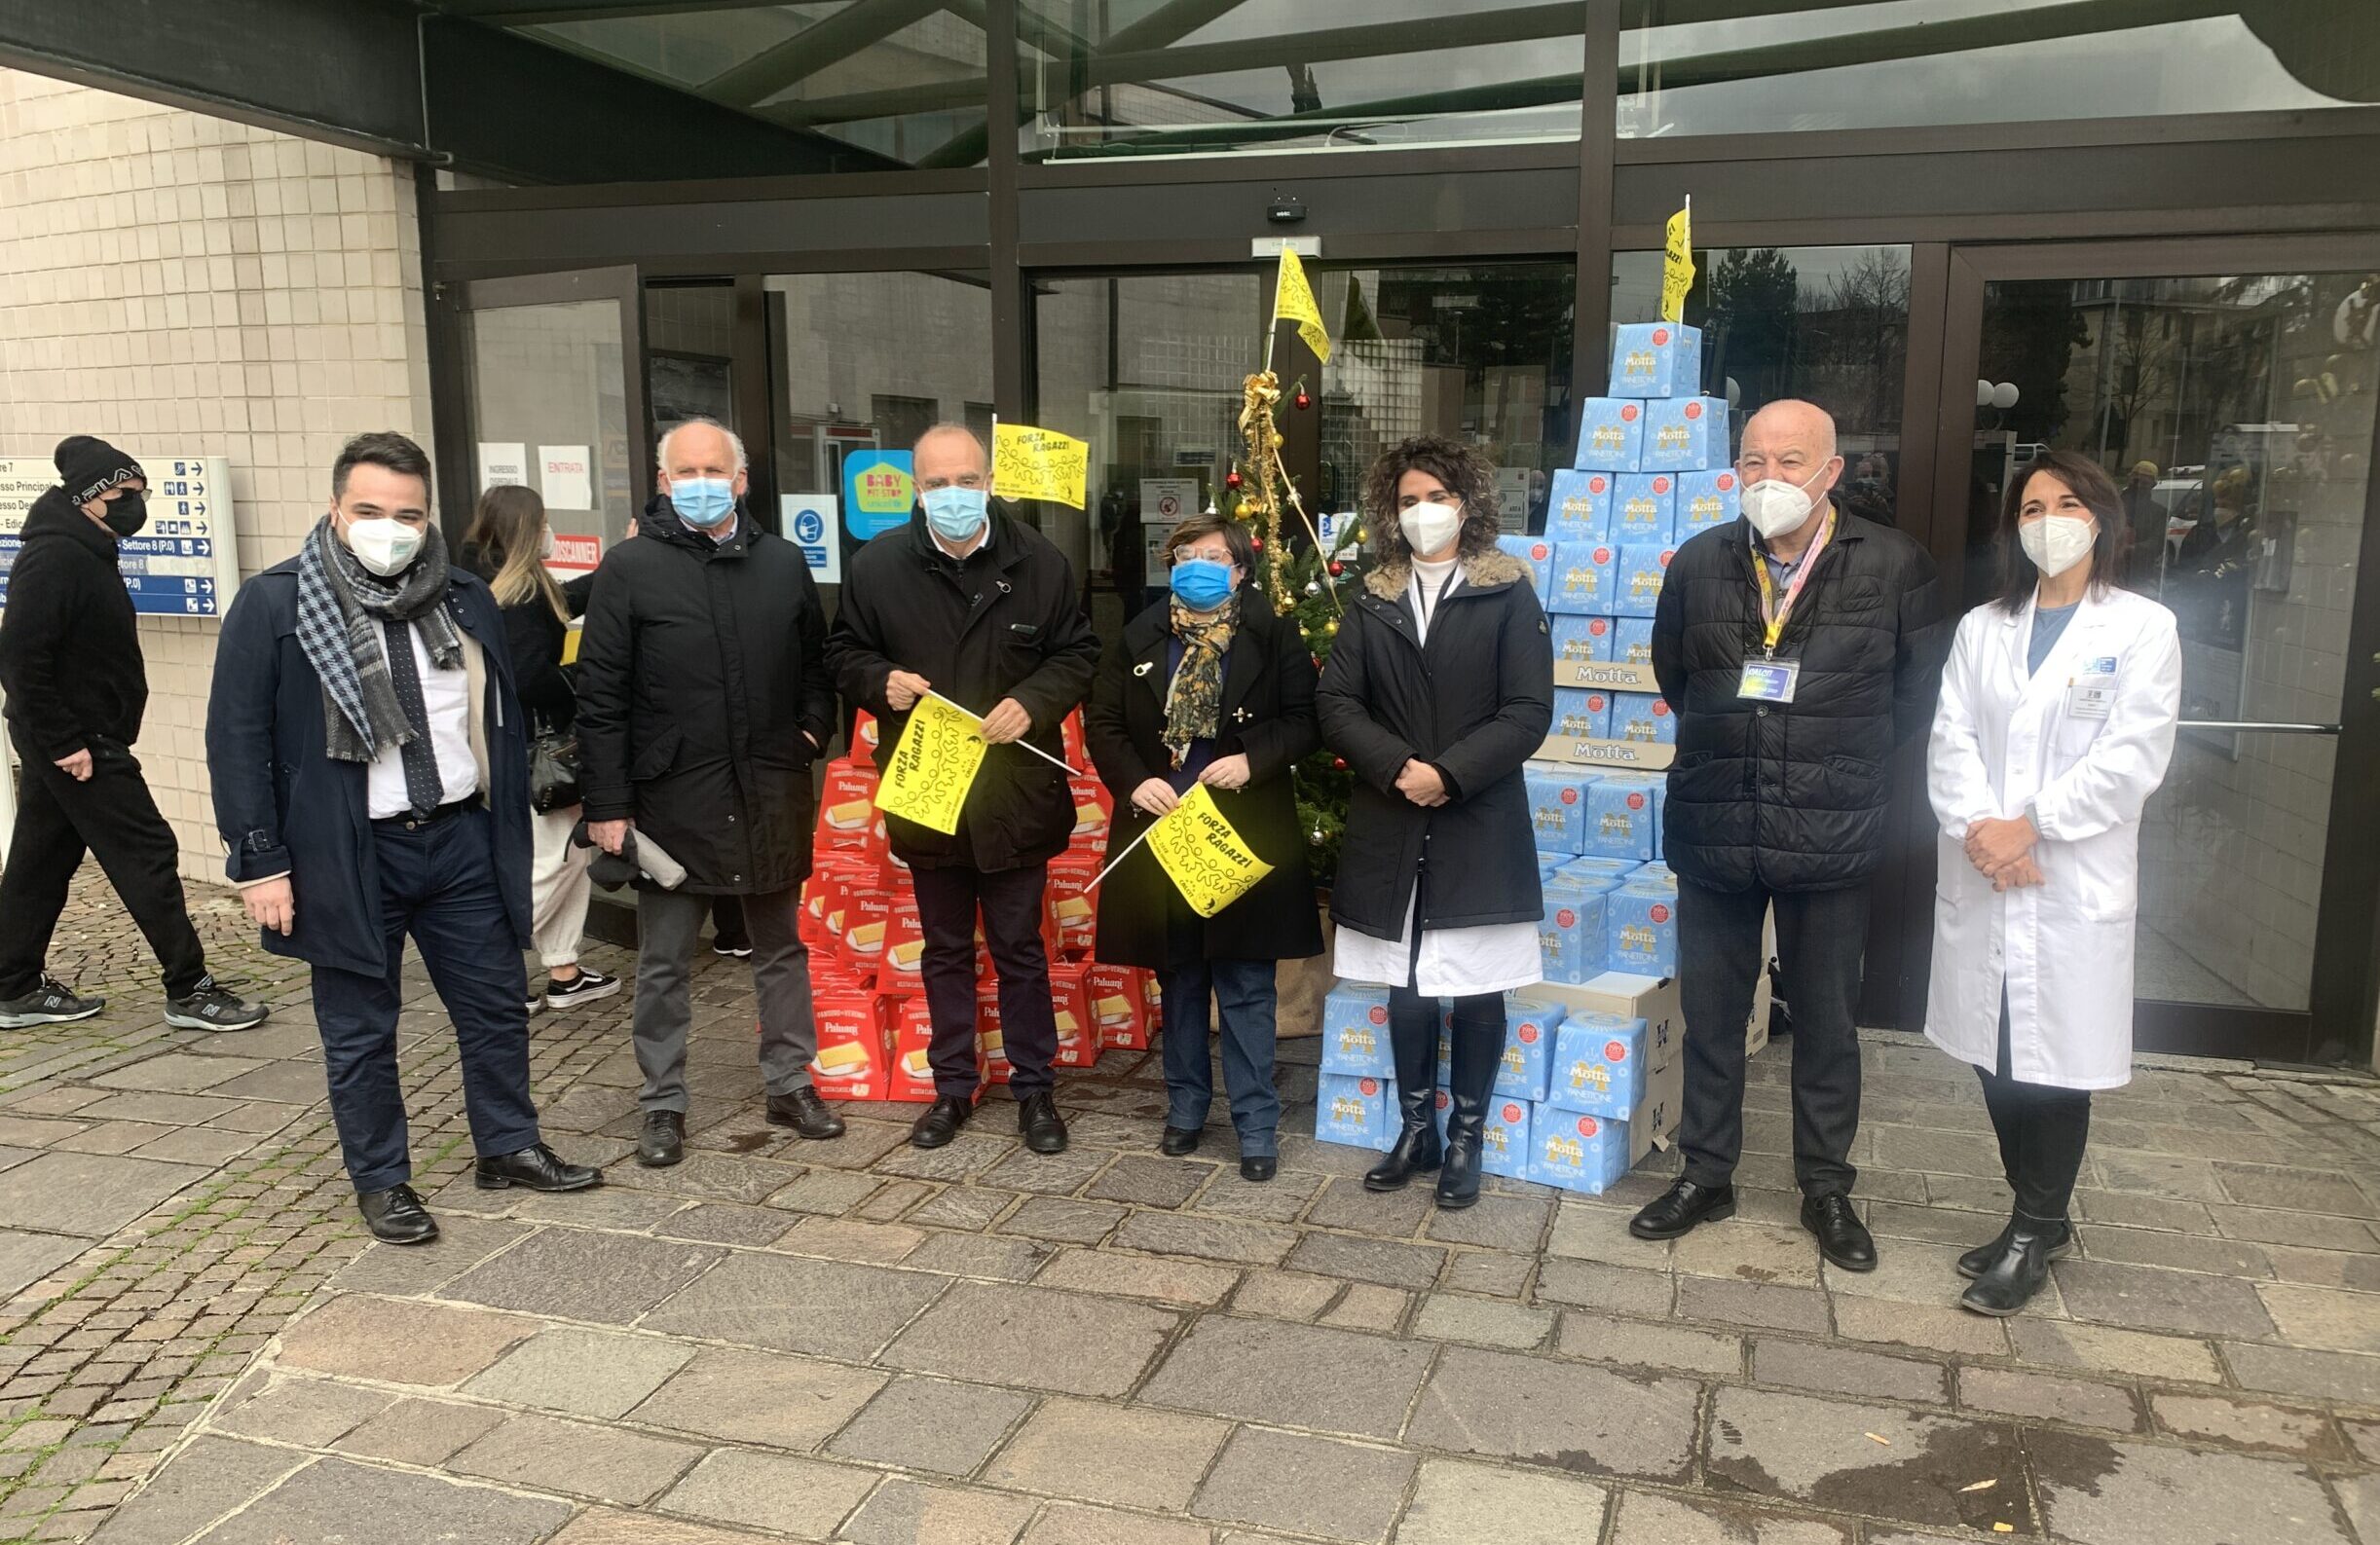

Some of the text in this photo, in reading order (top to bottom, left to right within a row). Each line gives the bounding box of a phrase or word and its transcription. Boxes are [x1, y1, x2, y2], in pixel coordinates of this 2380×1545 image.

[1624, 356, 1656, 366] Motta
[1017, 432, 1046, 446] FORZA
[1592, 430, 1625, 441] Motta
[1657, 430, 1691, 440] Motta
[1033, 441, 1069, 453] RAGAZZI
[8, 462, 14, 472] 7
[488, 465, 519, 474] INGRESSO
[548, 461, 584, 475] ENTRATA
[82, 467, 133, 502] FILA
[867, 474, 902, 487] BABY
[16, 481, 52, 494] Principa
[1561, 501, 1593, 513] Motta
[1624, 502, 1657, 514] Motta
[1690, 501, 1724, 513] Motta
[122, 539, 151, 551] Settore
[152, 540, 158, 551] 8
[139, 560, 145, 570] 8
[1565, 573, 1598, 583] Motta
[1631, 576, 1663, 587] Motta
[1562, 644, 1594, 654] Motta
[1576, 666, 1638, 684] Motta
[1560, 718, 1592, 730] Motta
[1624, 724, 1657, 735] Motta
[909, 718, 926, 772] RAGAZZI
[1574, 742, 1636, 761] Motta
[894, 750, 909, 790] FORZA
[838, 781, 868, 794] Paluani
[1534, 811, 1566, 824] Motta
[1599, 817, 1633, 828] Motta
[1197, 812, 1232, 839] FORZA
[1206, 832, 1253, 868] RAGAZZI
[1054, 878, 1083, 892] Paluani
[860, 900, 889, 913] Paluan
[1539, 937, 1563, 948] otta
[1619, 930, 1656, 943] Motta
[1093, 976, 1124, 990] Paluani
[44, 995, 61, 1008] N
[1052, 994, 1069, 1006] uani
[202, 1004, 220, 1017] N
[825, 1021, 859, 1036] Paluani
[1338, 1033, 1377, 1046] Motta
[1501, 1052, 1526, 1064] otta
[1569, 1066, 1612, 1083] Motta
[1331, 1102, 1366, 1116] Motta
[1483, 1131, 1509, 1144] otta
[1544, 1141, 1584, 1158] Motta
